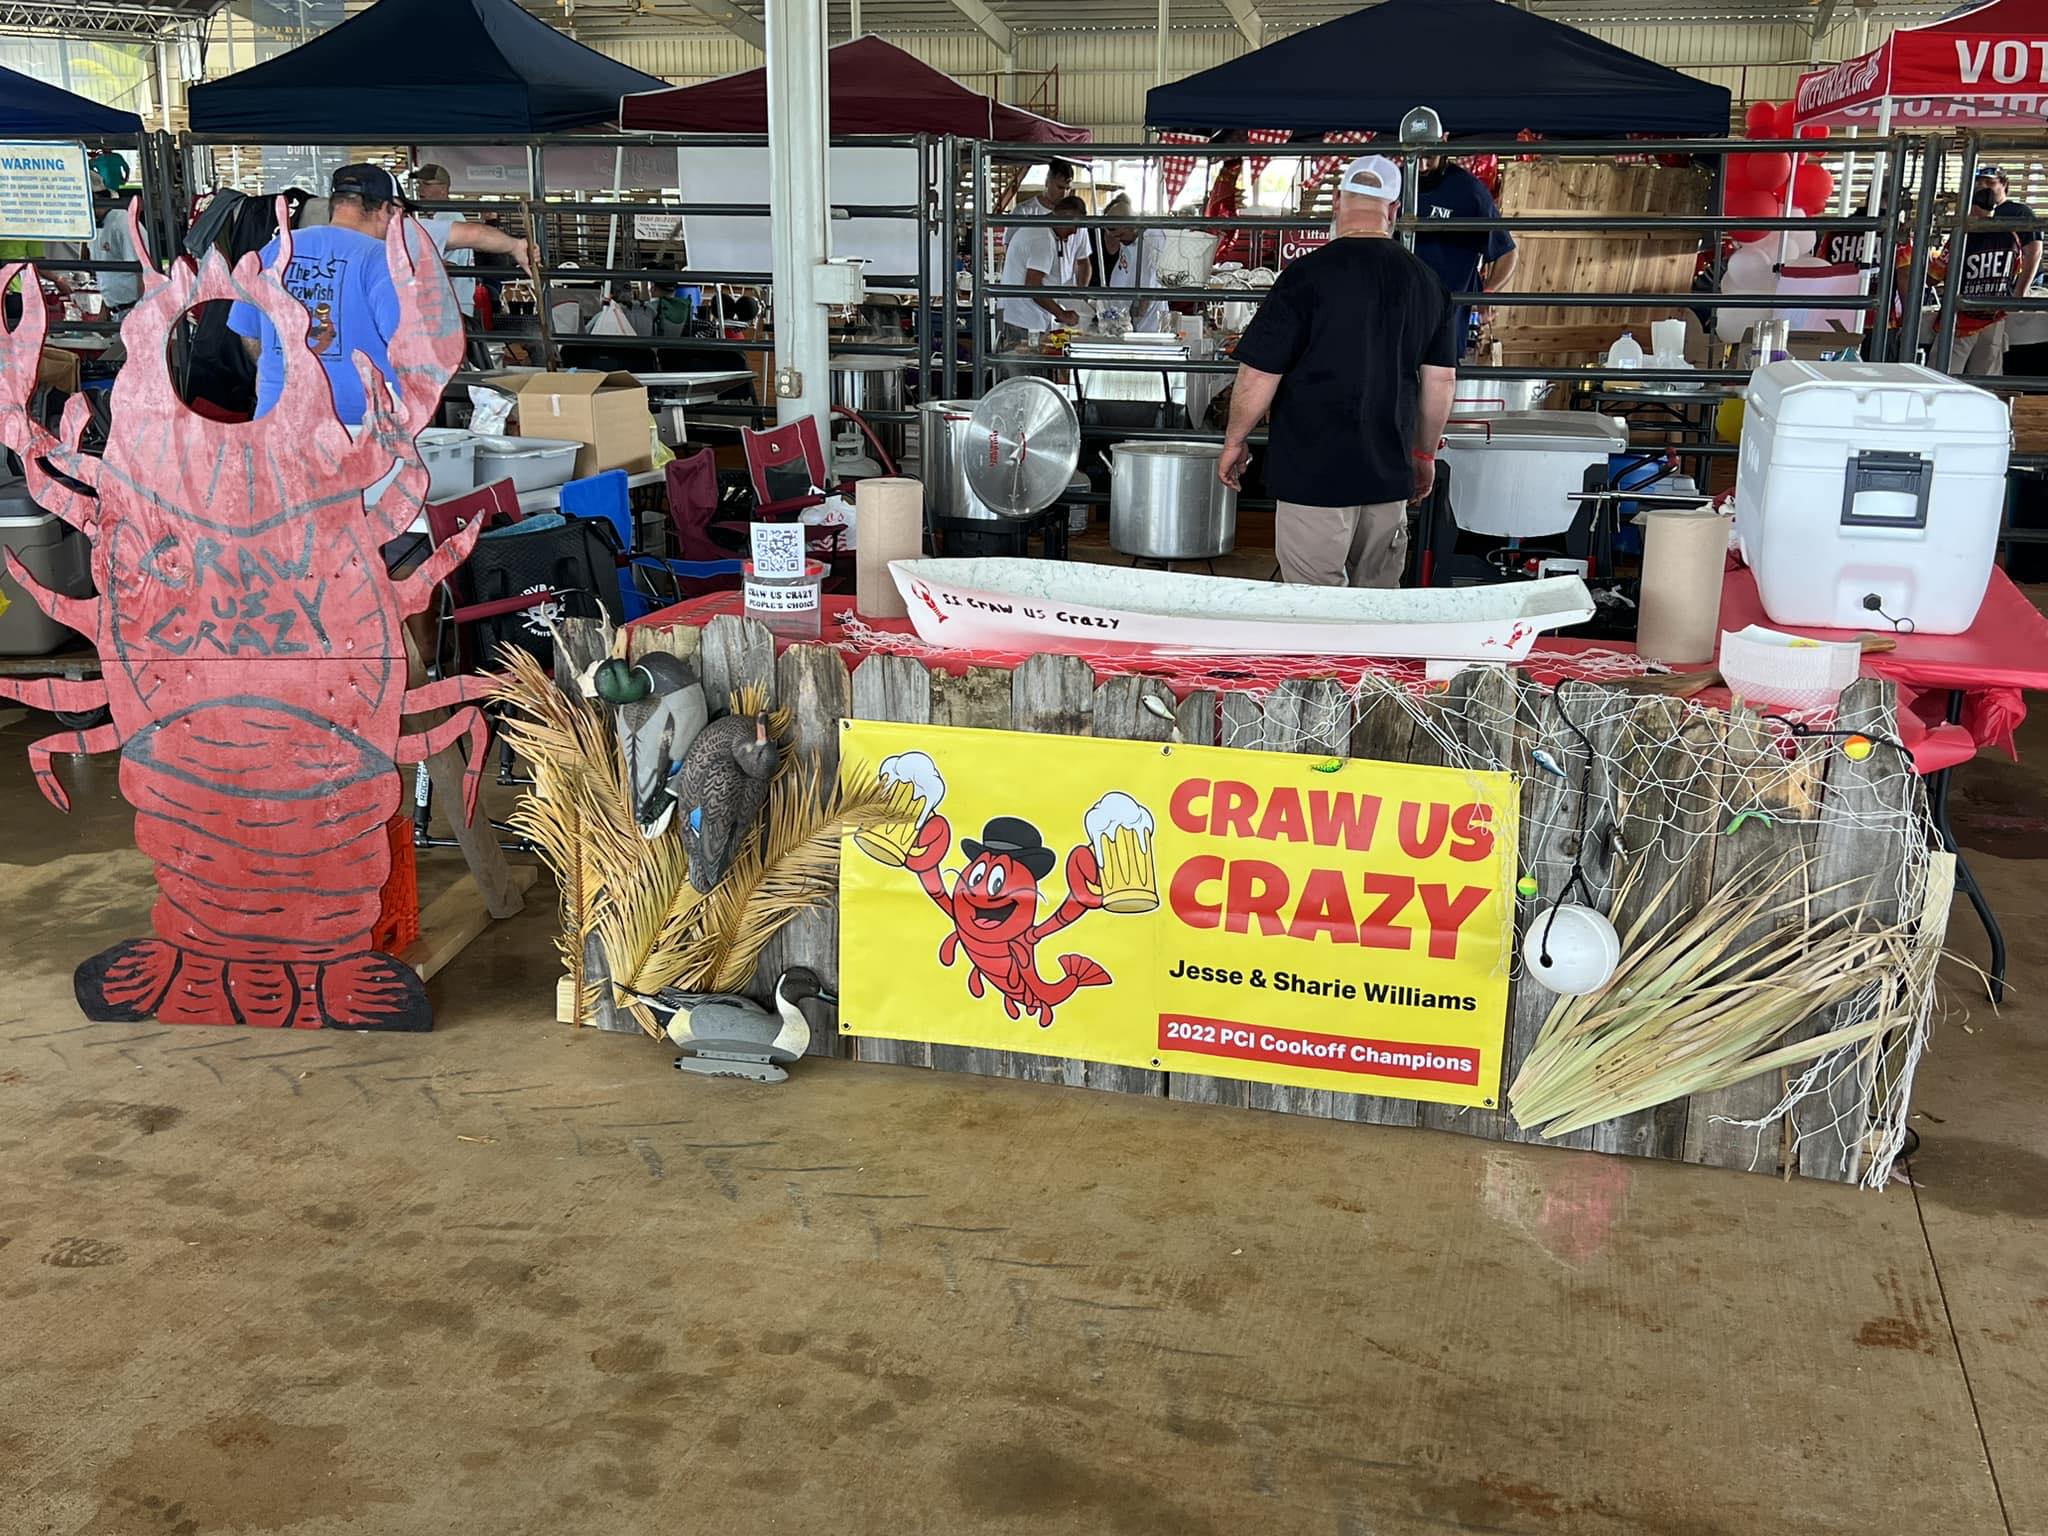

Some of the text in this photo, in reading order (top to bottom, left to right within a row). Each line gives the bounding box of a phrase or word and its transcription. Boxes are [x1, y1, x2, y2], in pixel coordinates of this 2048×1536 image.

[1, 158, 65, 170] WARNING
[289, 262, 312, 281] The
[139, 523, 315, 592] CRAW
[147, 578, 332, 654] CRAZY
[748, 588, 813, 599] CRAW US CRAZY
[749, 599, 814, 609] PEOPLE'S CHOICE
[1169, 778, 1495, 862] CRAW US
[1169, 854, 1493, 960] CRAZY
[1169, 959, 1477, 1012] Jesse & Sharie Williams
[1167, 1022, 1472, 1073] 2022 PCI Cookoff Champions
